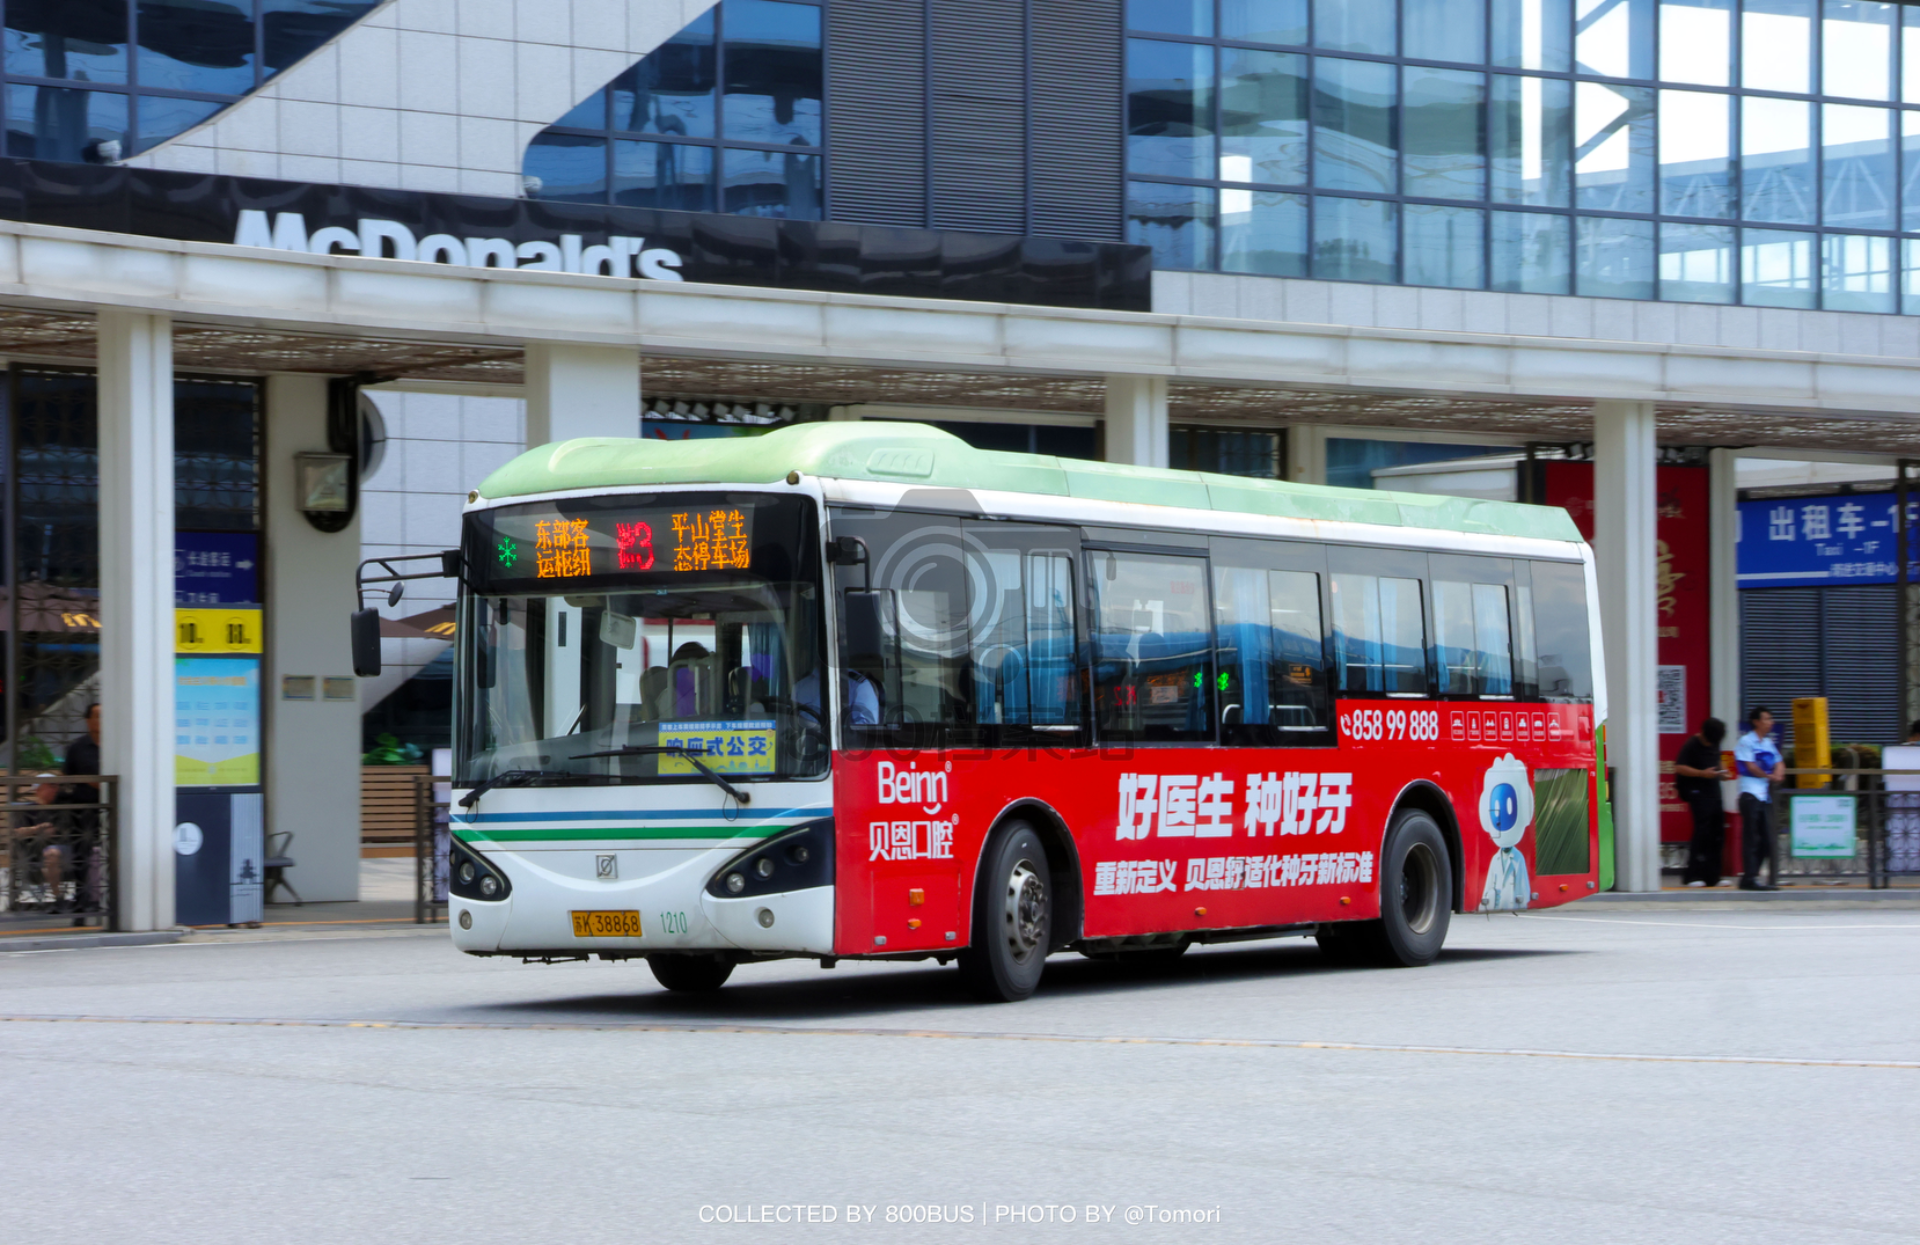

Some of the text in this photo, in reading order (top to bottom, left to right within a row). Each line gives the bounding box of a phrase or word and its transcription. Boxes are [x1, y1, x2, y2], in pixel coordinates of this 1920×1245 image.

[234, 209, 683, 282] McDonald's
[1352, 709, 1439, 741] 858 99 888
[1115, 771, 1353, 841] 好医生 种好牙
[868, 820, 955, 862] 贝恩口腔
[1093, 858, 1178, 896] 重新定义
[660, 911, 688, 934] 1210
